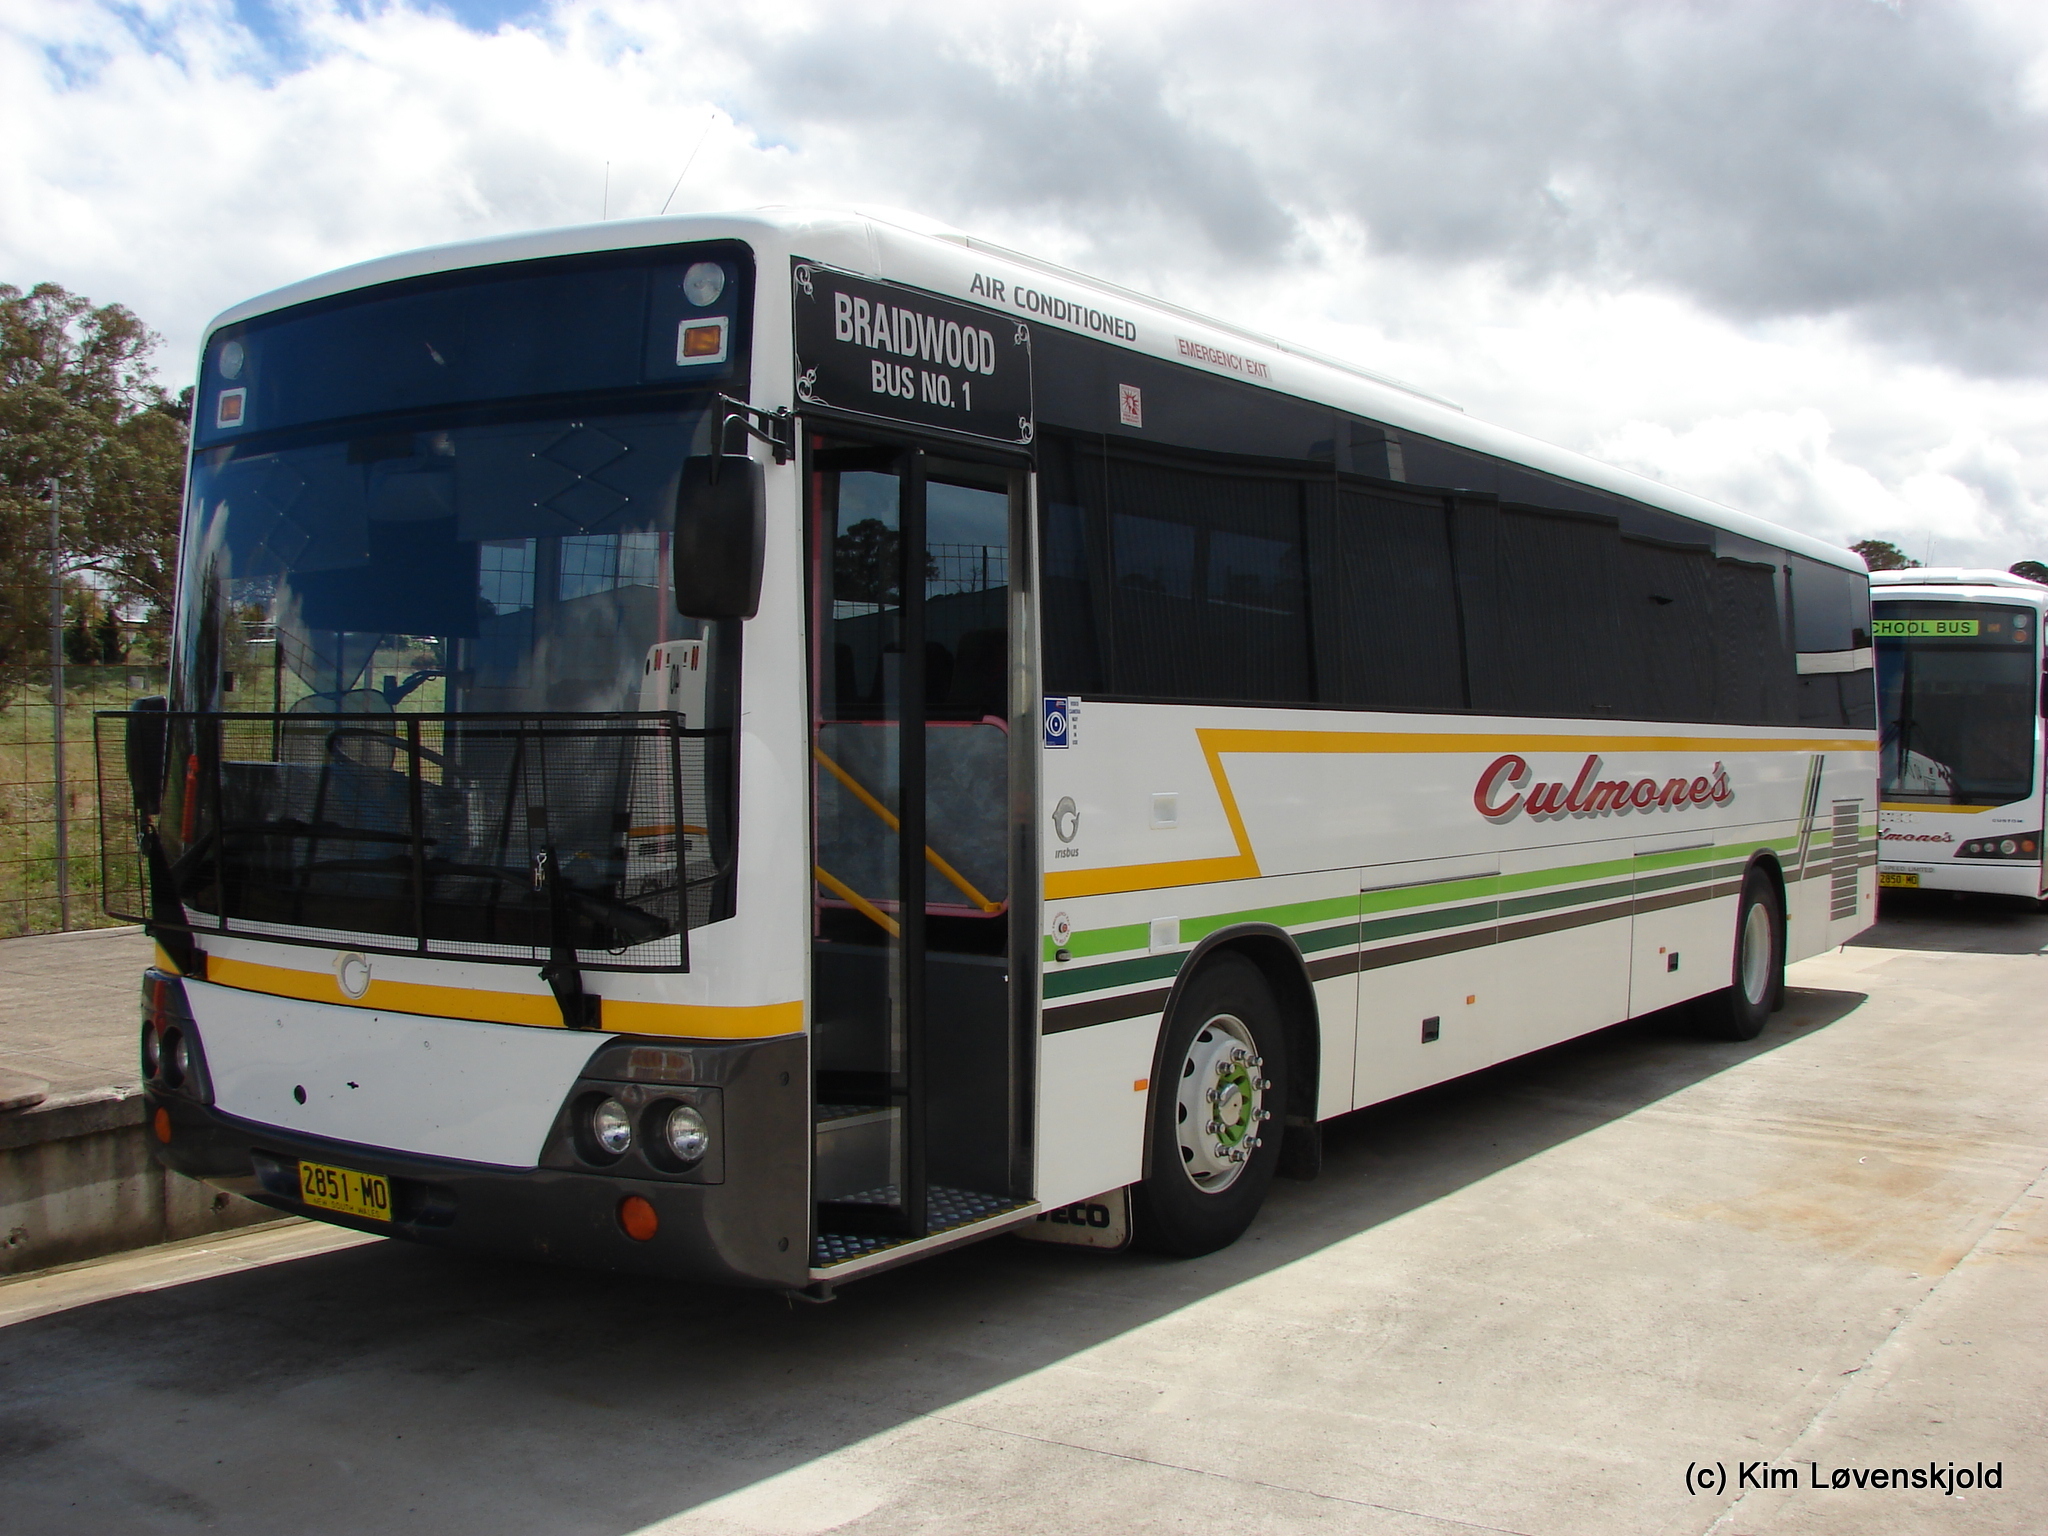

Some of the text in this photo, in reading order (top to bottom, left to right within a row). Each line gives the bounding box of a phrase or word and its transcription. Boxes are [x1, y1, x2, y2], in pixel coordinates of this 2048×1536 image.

[834, 291, 995, 375] BRAIDWOOD
[970, 272, 1137, 342] AIR CONDITIONED
[1178, 339, 1268, 378] EMERGENCY EXIT
[871, 359, 971, 411] BUS NO. 1
[1873, 622, 1971, 634] CHOOL BUS
[1473, 754, 1735, 824] Culmone's
[1036, 1202, 1110, 1229] ECO
